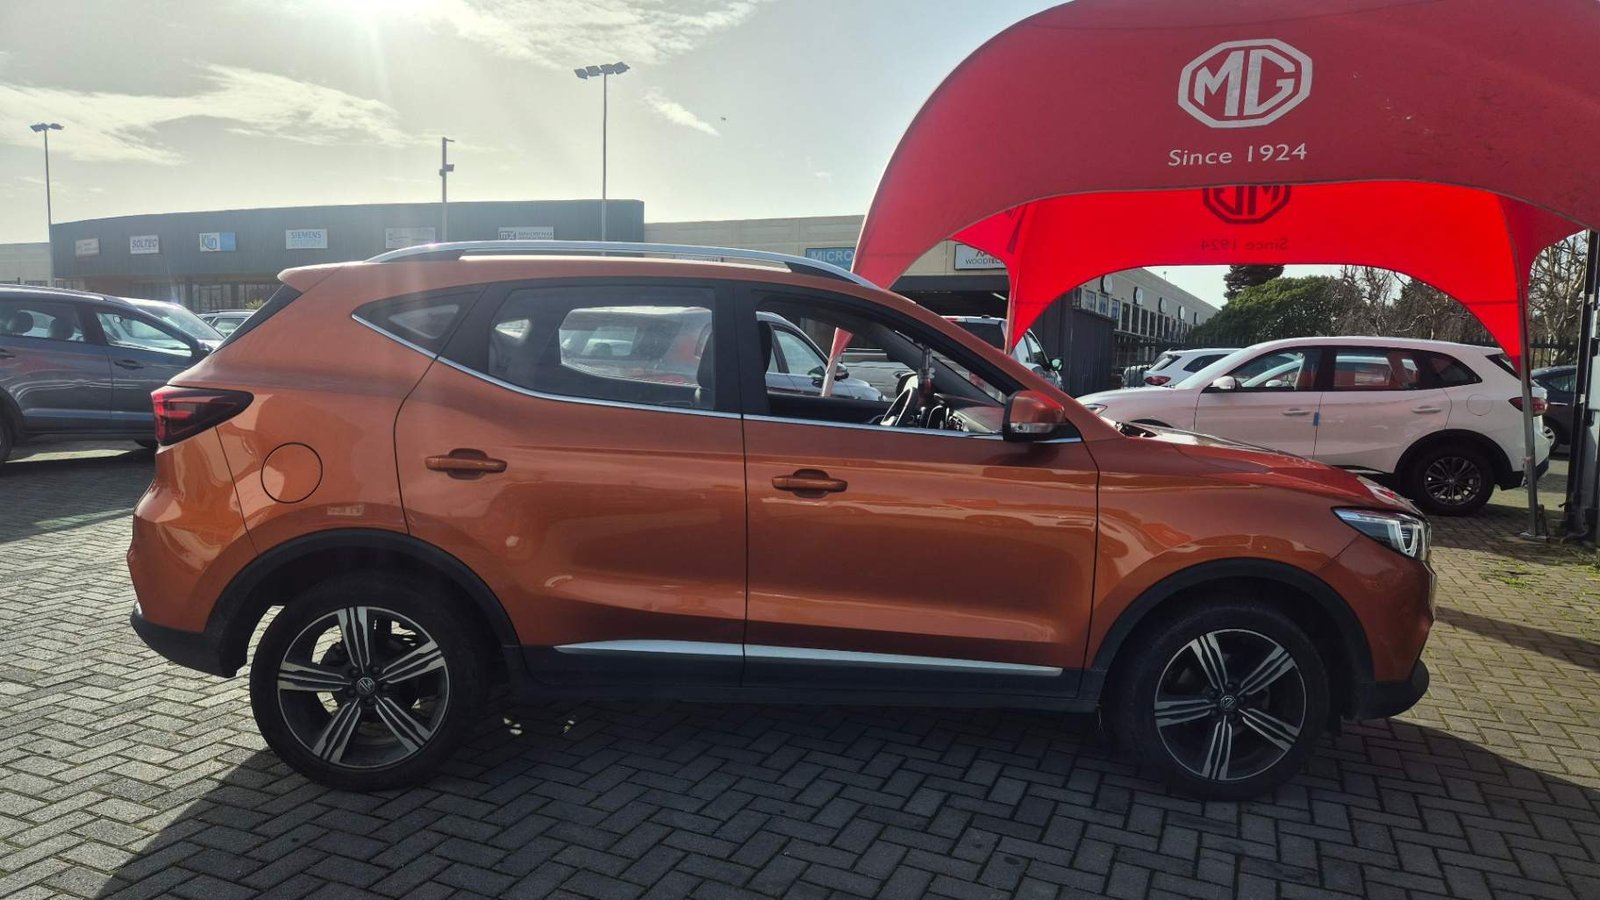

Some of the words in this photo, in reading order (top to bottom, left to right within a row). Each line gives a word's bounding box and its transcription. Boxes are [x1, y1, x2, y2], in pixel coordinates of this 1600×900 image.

[1193, 48, 1296, 117] MG
[1167, 149, 1233, 166] Since
[1247, 143, 1308, 162] 1924
[291, 231, 321, 239] SIEMENS
